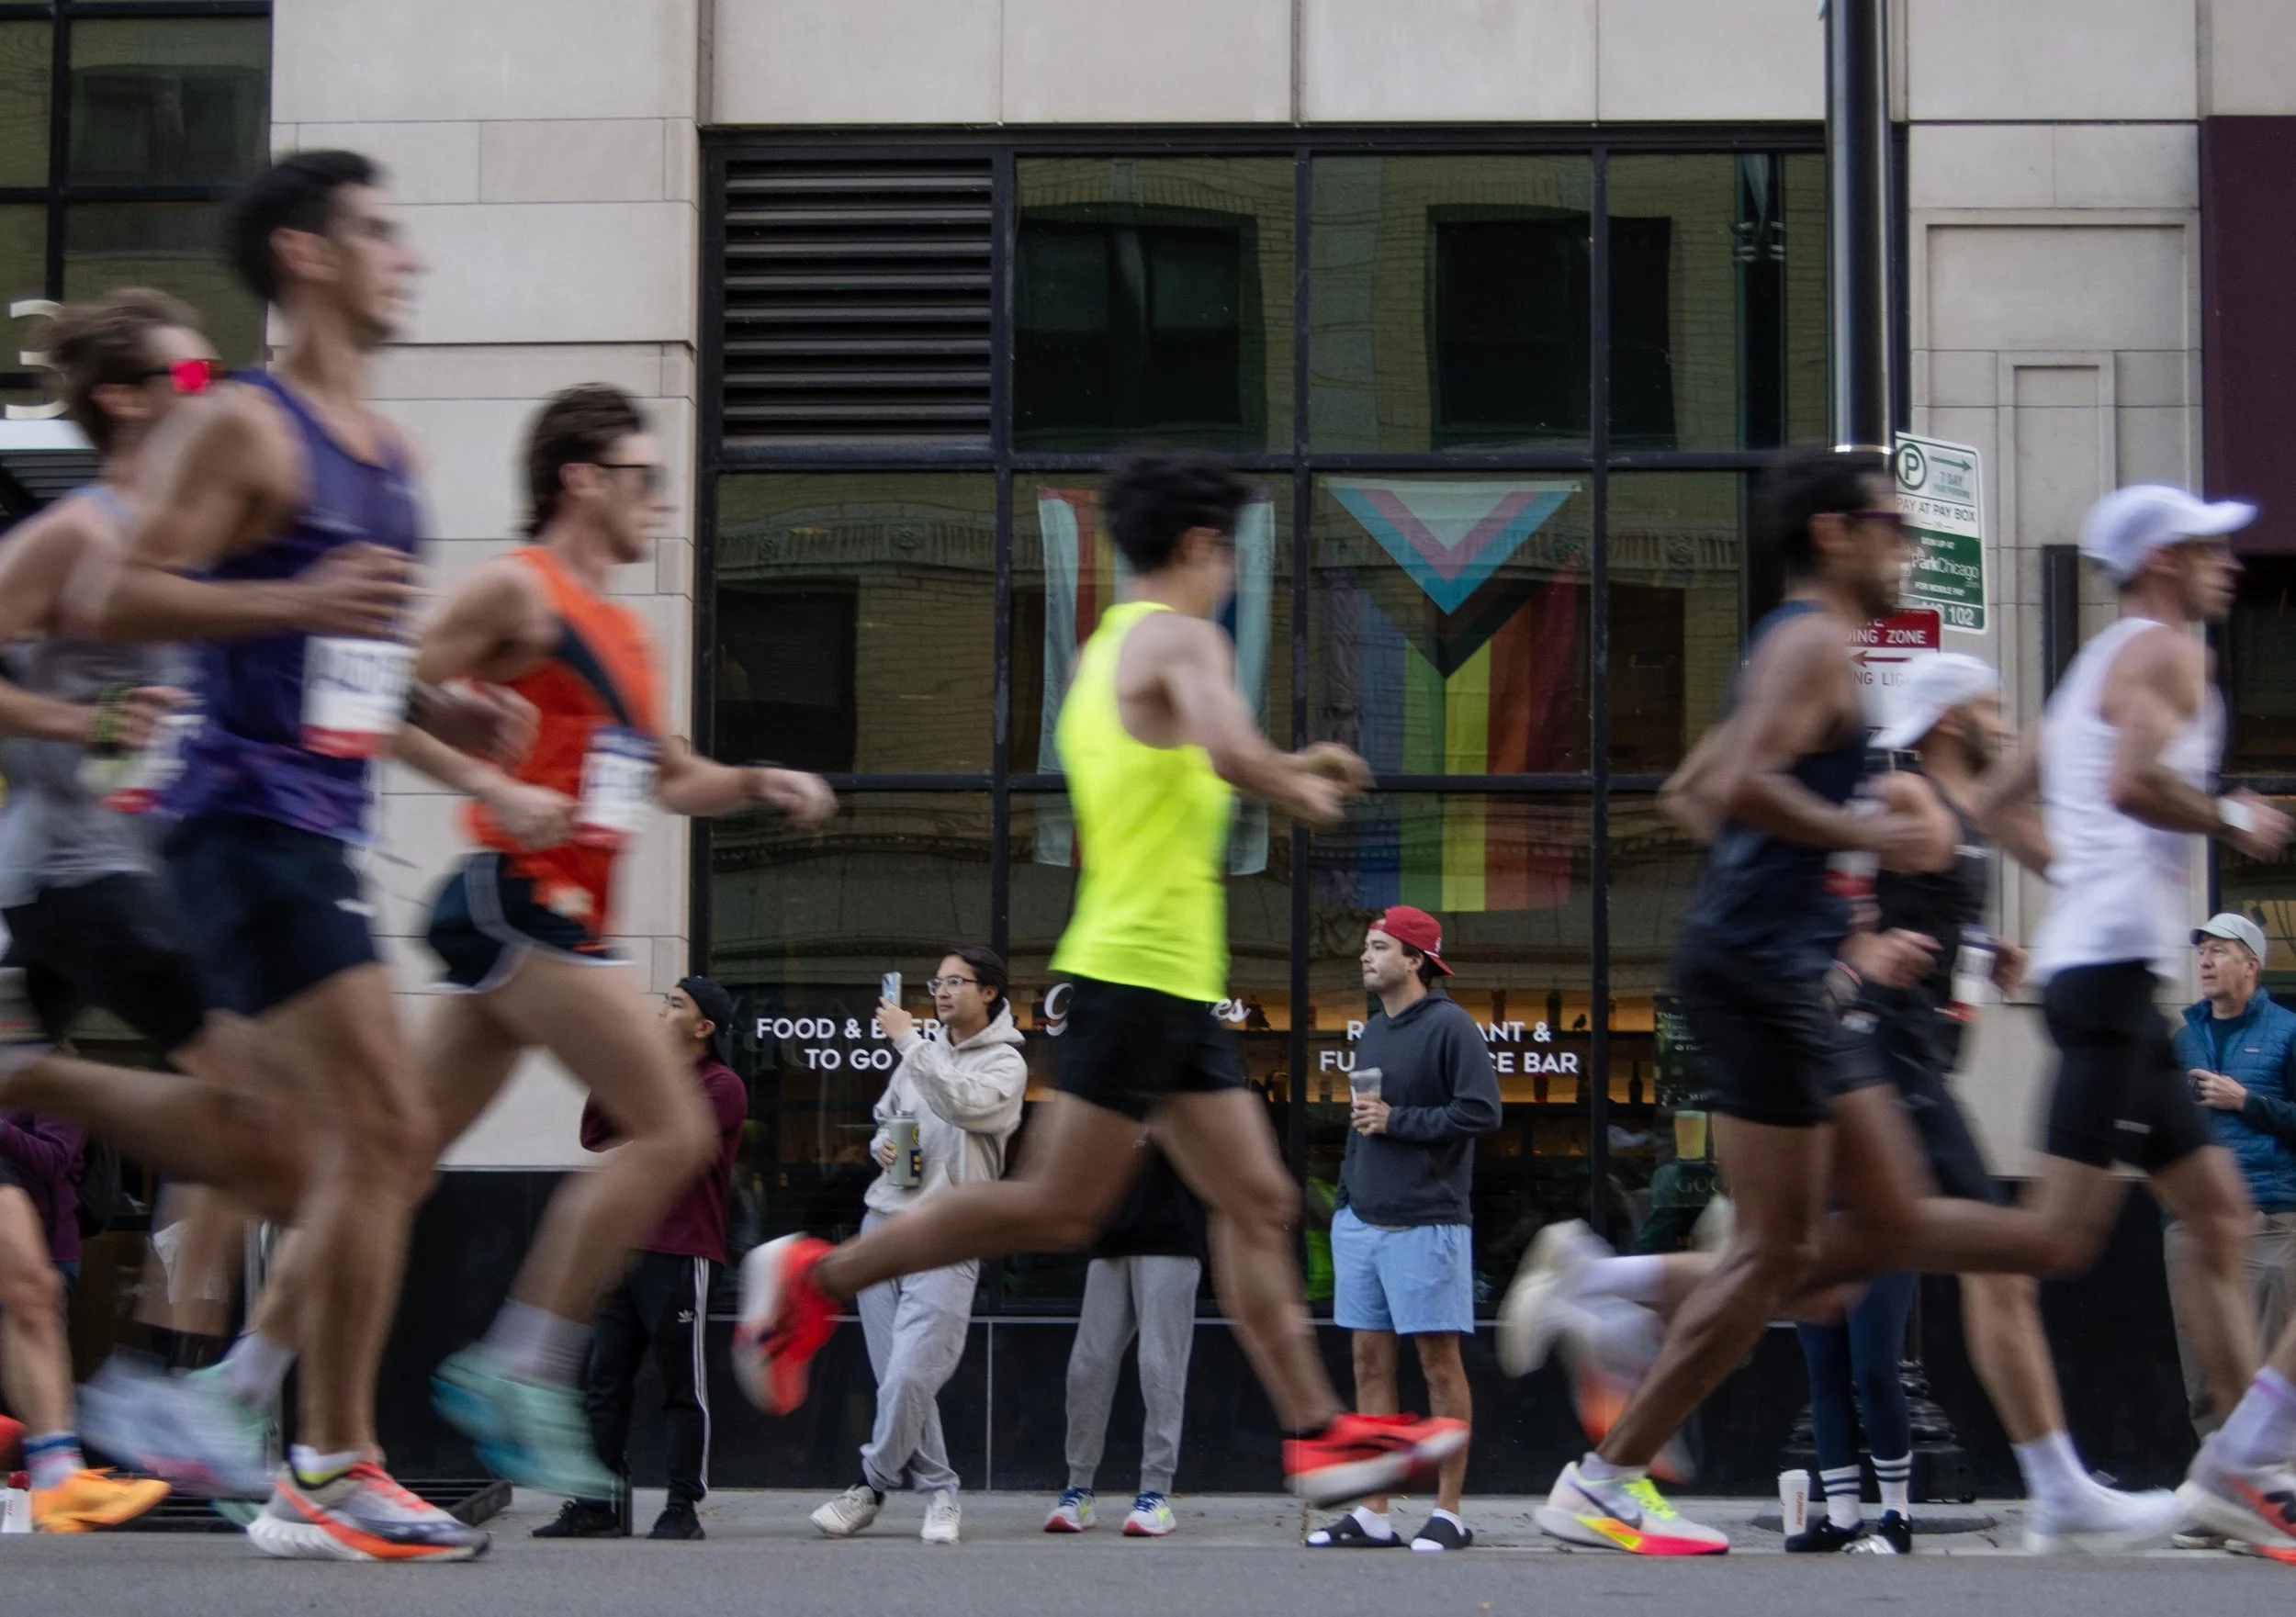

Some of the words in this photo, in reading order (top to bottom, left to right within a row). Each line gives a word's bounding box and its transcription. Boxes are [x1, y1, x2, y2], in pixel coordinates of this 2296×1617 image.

[1896, 498, 1915, 511] PAY
[1919, 501, 1931, 513] AT
[1933, 504, 1951, 517] PAY
[1954, 508, 1976, 522] BOX
[1949, 606, 1975, 626] 102
[1885, 630, 1927, 644] ZONE
[756, 1018, 836, 1039] FOOD
[844, 1018, 862, 1039] &
[1532, 1021, 1552, 1043] &
[804, 1049, 842, 1070] TO
[850, 1049, 893, 1070] GO
[1319, 1050, 1356, 1072] FU
[1523, 1052, 1580, 1073] BAR
